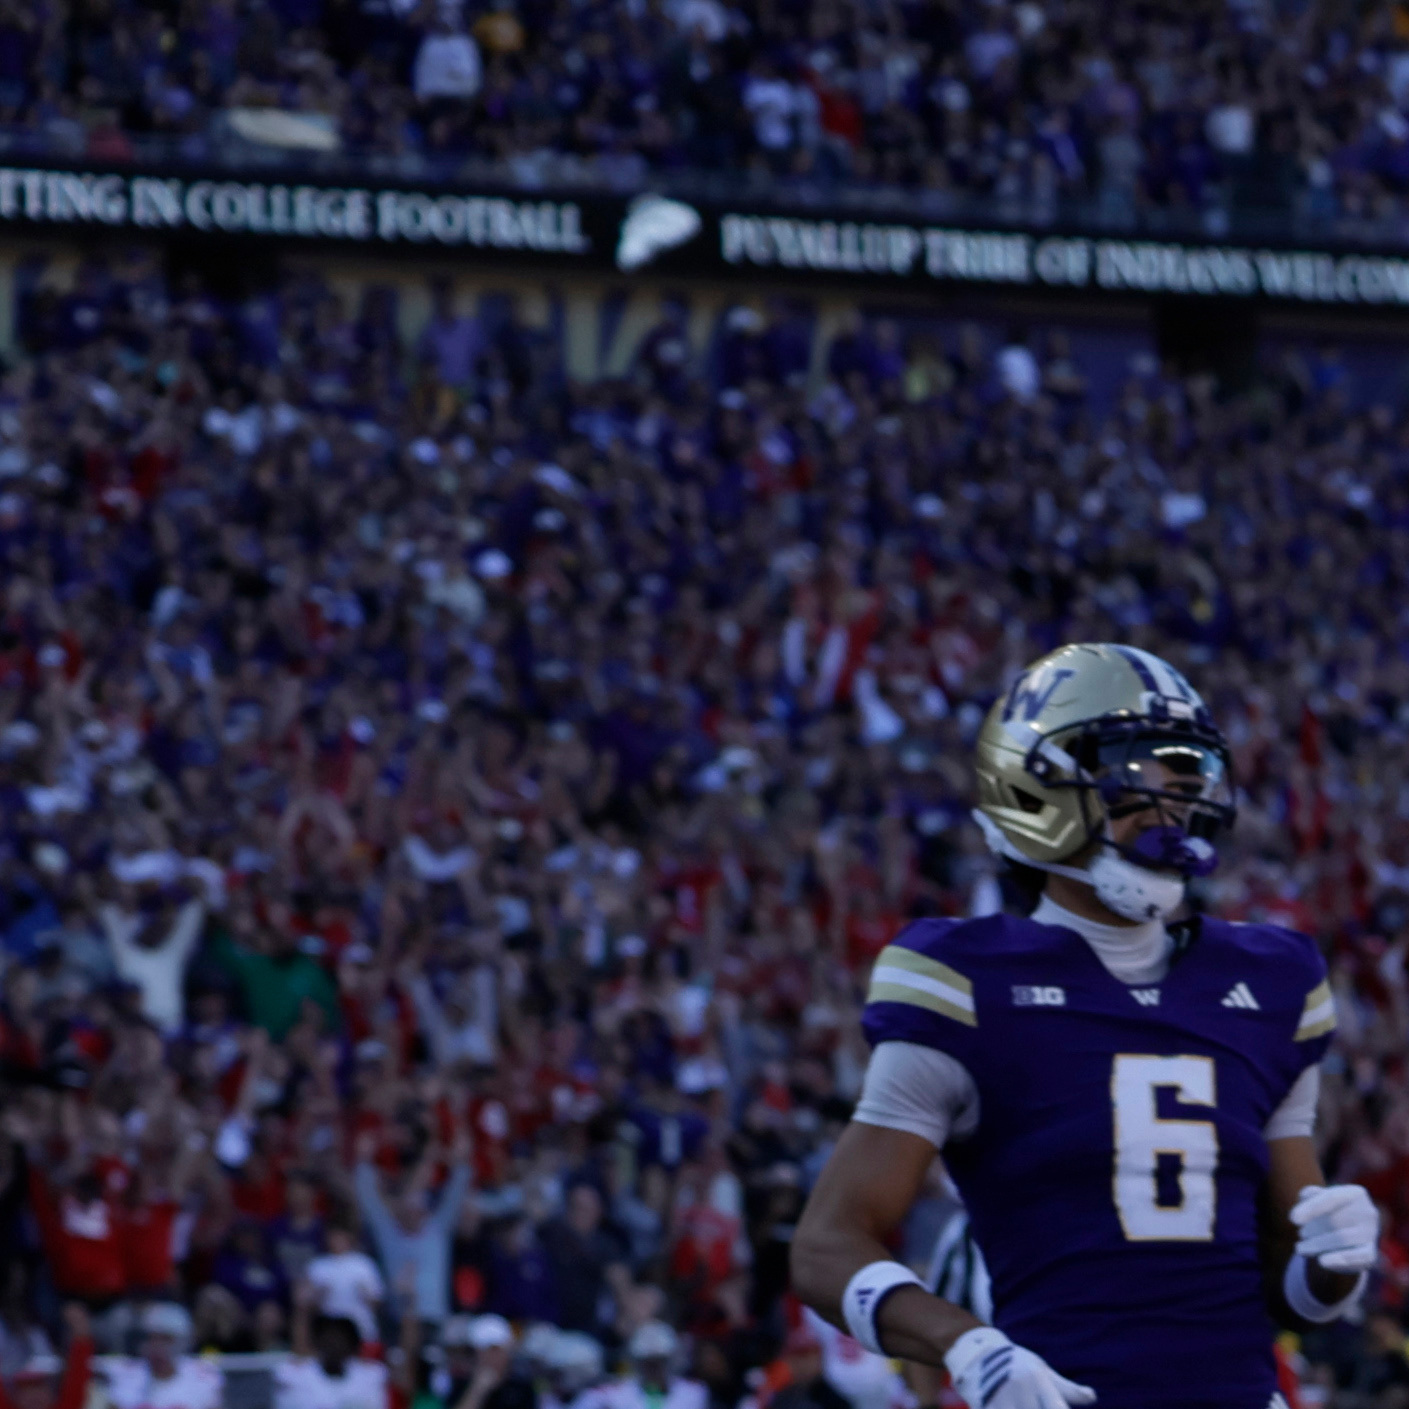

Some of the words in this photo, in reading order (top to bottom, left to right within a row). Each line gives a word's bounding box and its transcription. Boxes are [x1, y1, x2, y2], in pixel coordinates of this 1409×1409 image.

[131, 174, 183, 229] IN
[185, 180, 375, 244] COLLEGE
[376, 189, 590, 253] FOOTBALL
[1110, 1052, 1220, 1243] 6
